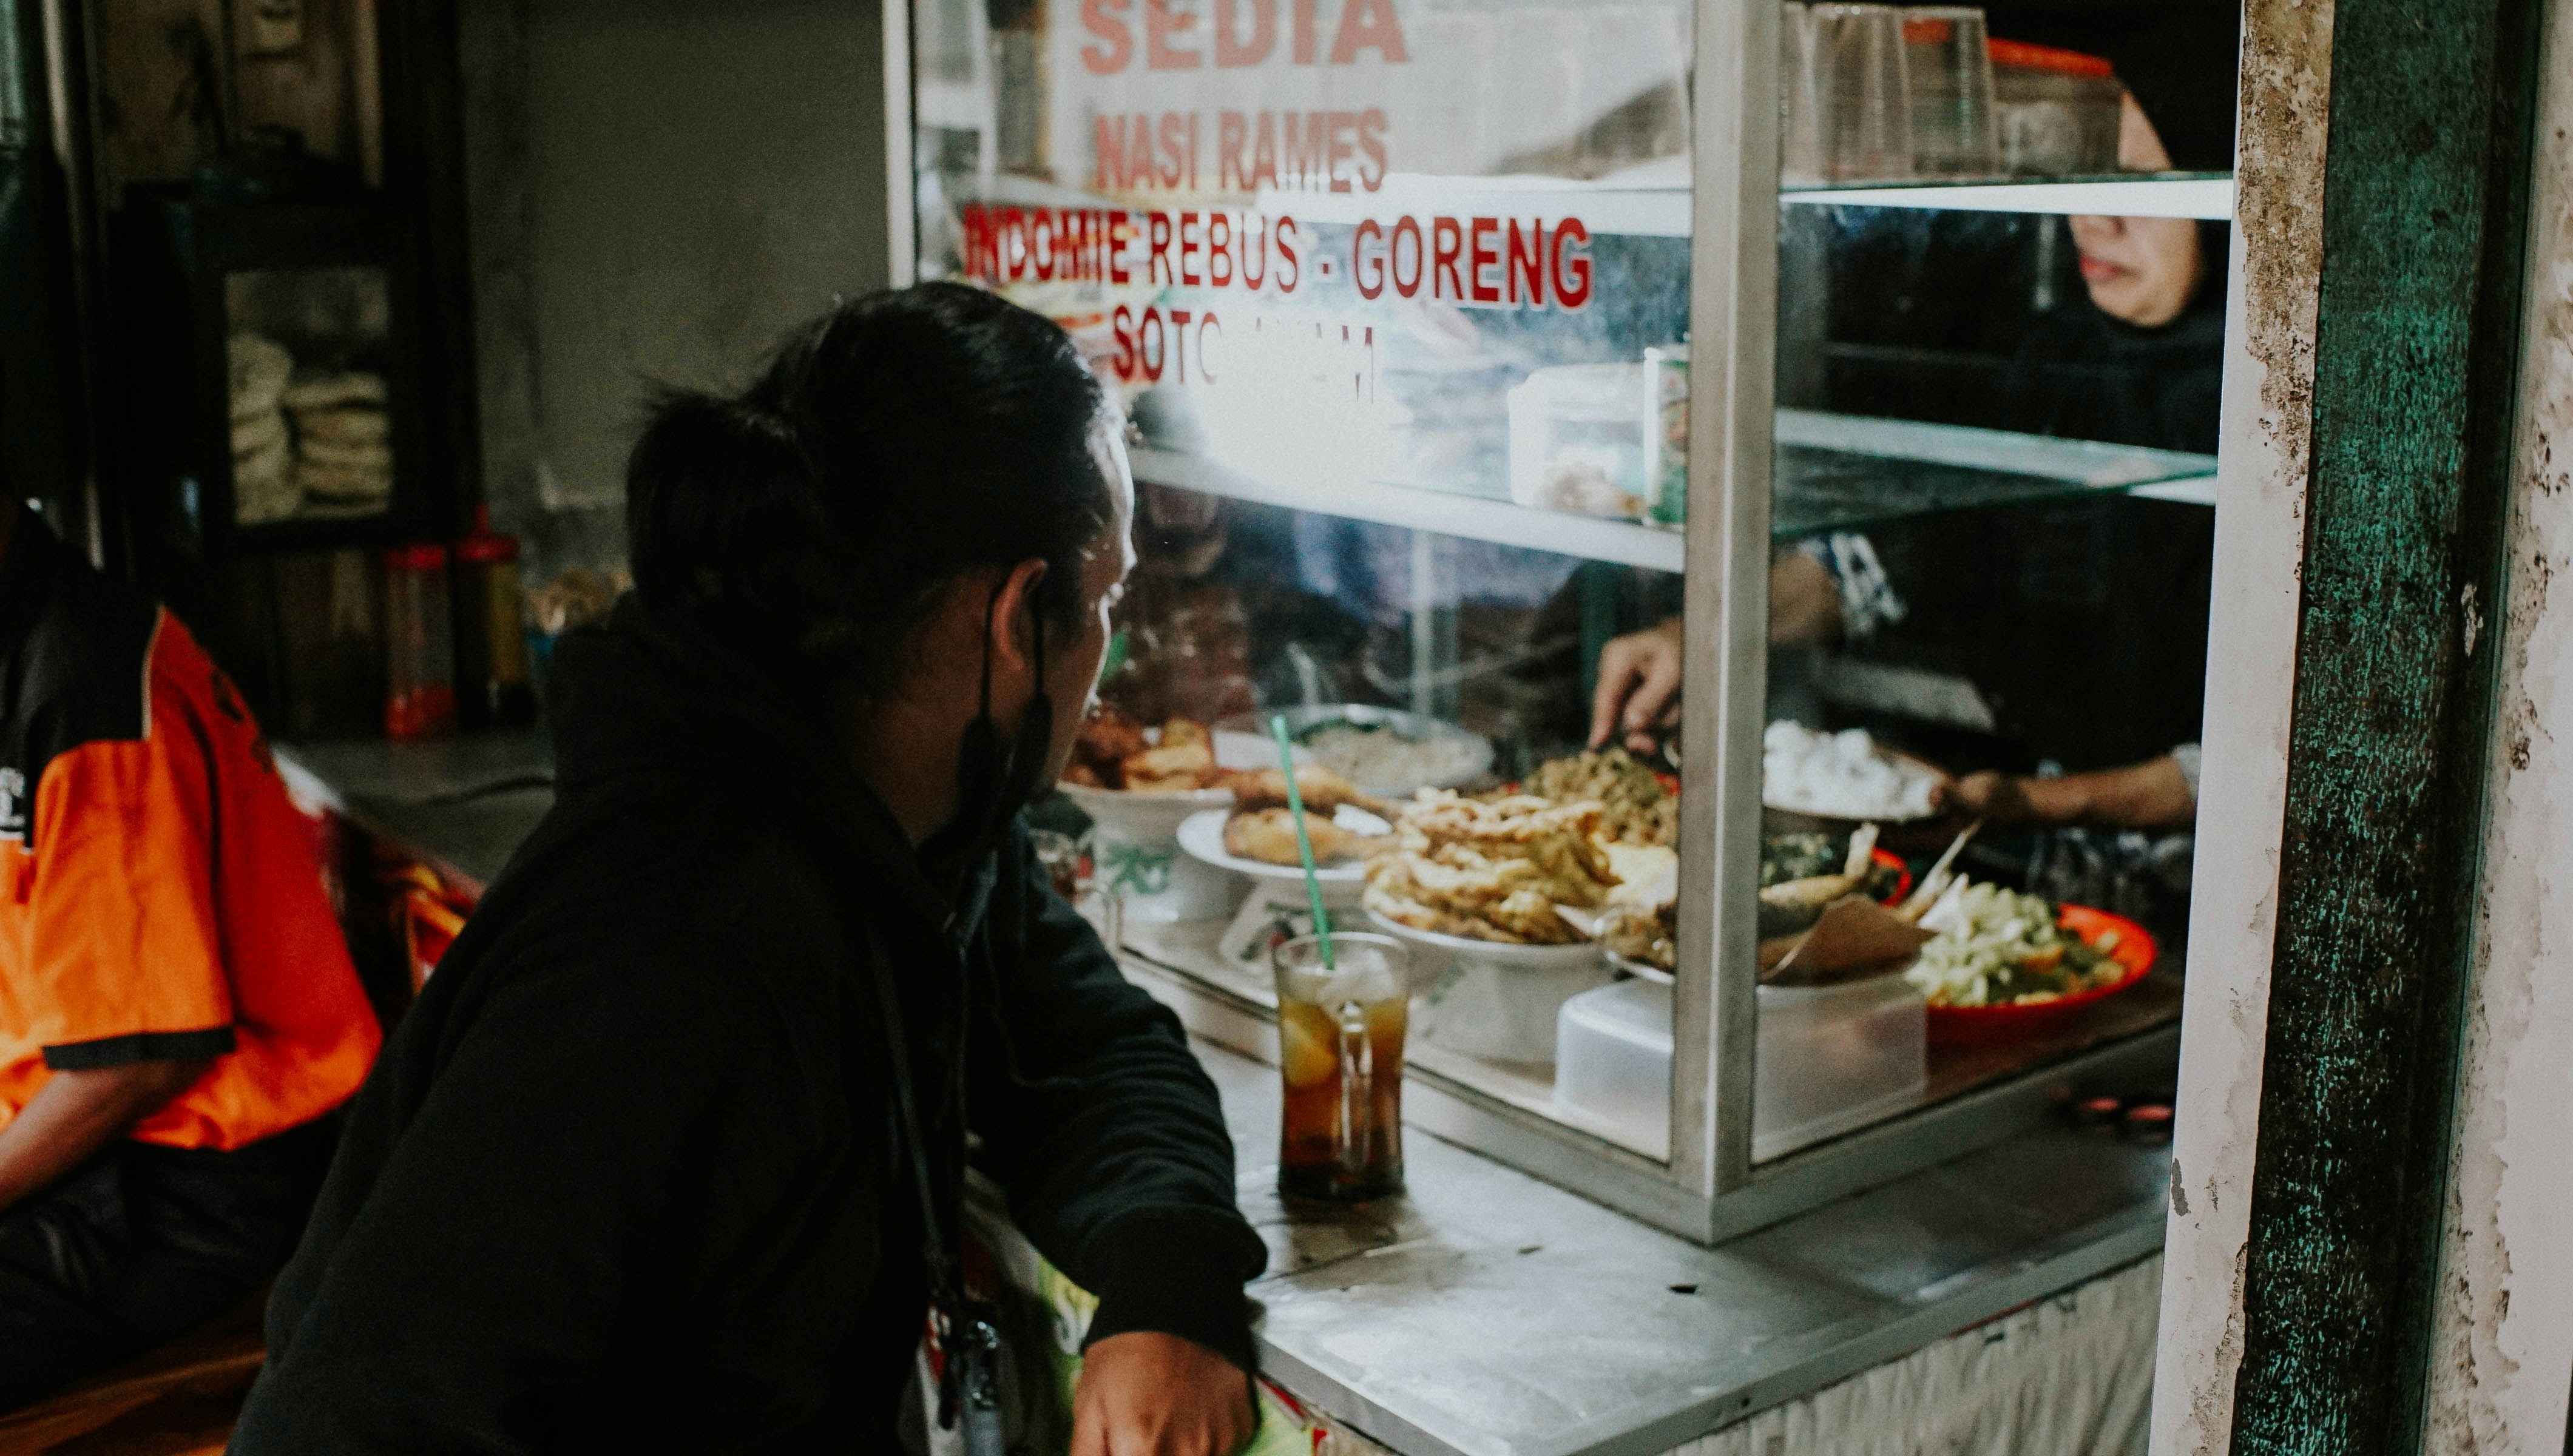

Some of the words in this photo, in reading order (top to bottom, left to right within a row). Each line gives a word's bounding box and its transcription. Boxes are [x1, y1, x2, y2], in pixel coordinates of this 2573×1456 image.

[1080, 0, 1407, 74] SEDIA
[1096, 111, 1199, 190] NASI
[1219, 108, 1388, 192] RAMES
[964, 205, 1129, 284] INDOMIE
[1149, 212, 1298, 293] REBUS
[1354, 215, 1591, 308] GORENG
